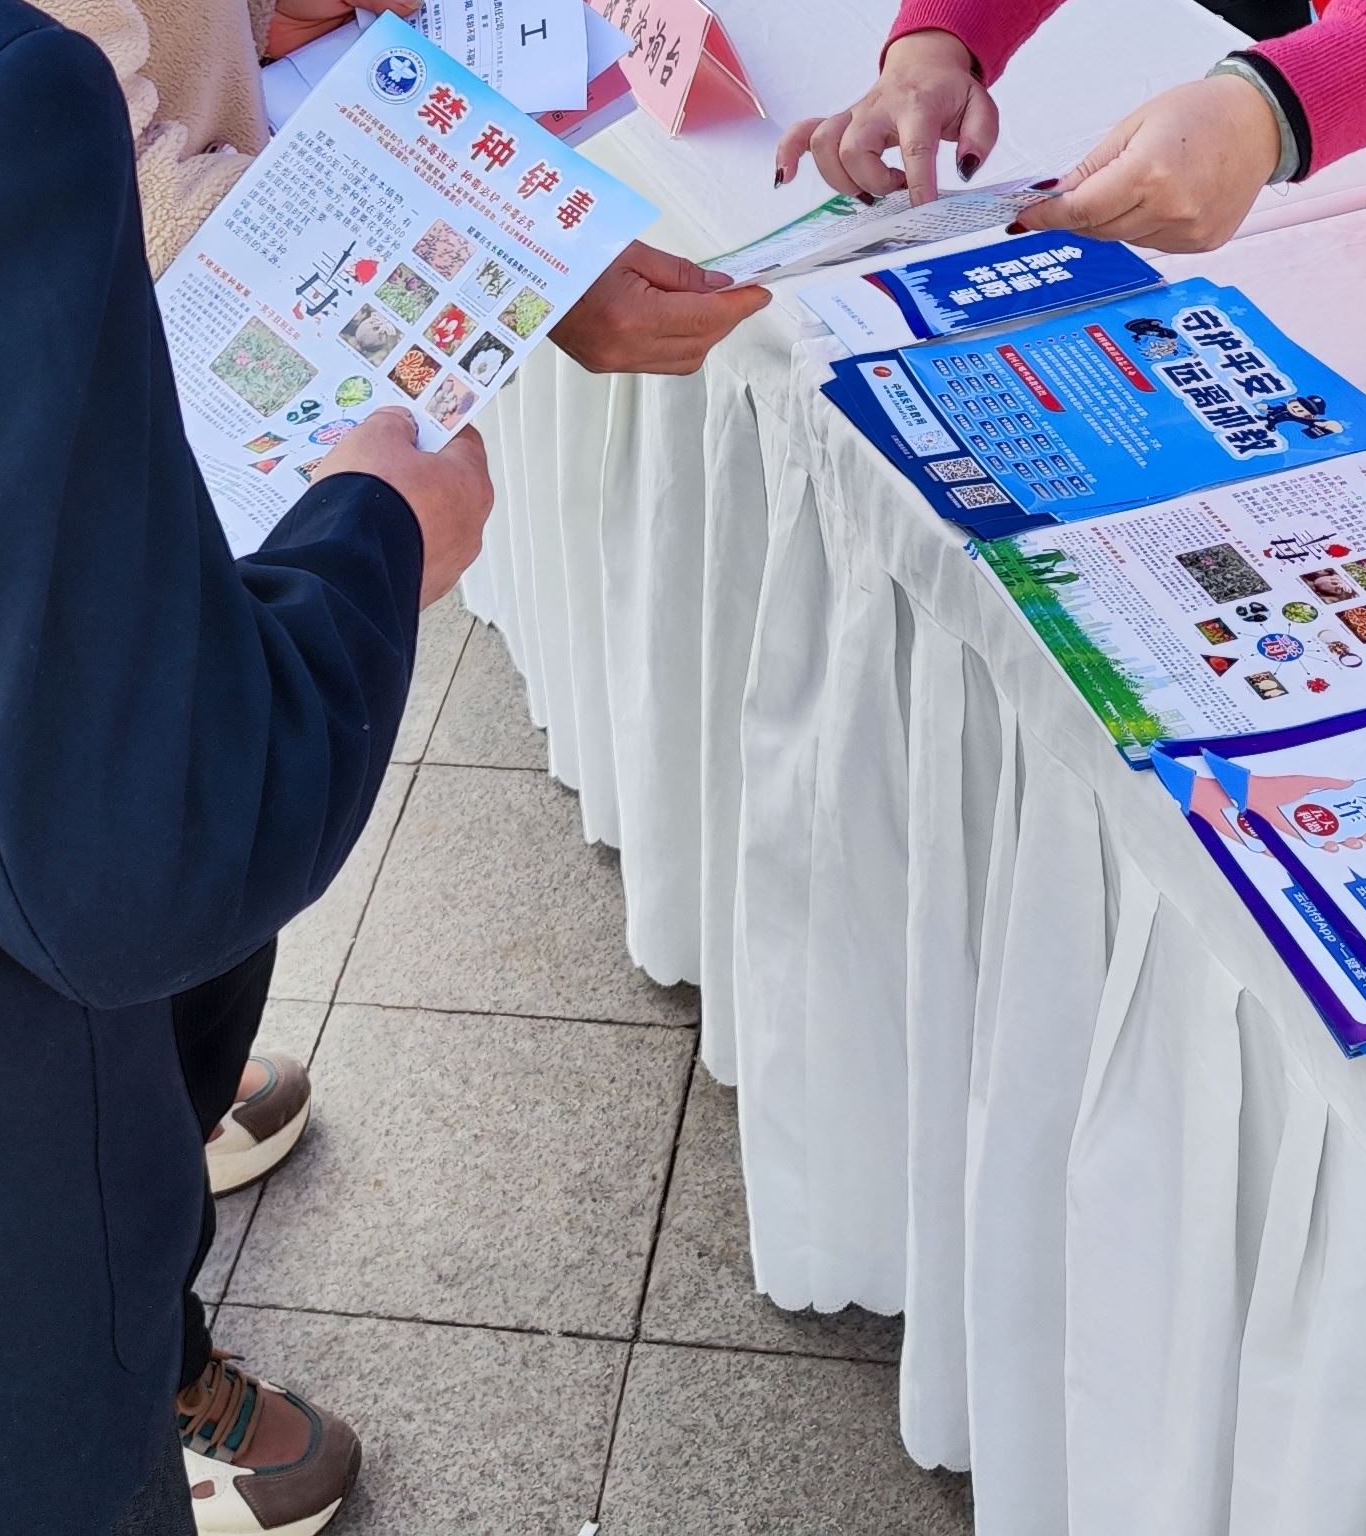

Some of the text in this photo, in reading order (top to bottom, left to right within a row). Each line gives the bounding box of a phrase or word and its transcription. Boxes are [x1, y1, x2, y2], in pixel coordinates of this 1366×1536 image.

[411, 82, 599, 233] 禁种铲毒
[956, 243, 1088, 284] 全民反诈
[1170, 309, 1292, 399] 守护平安
[1158, 360, 1279, 455] 远离邪教
[1289, 809, 1328, 835] 利器
[1306, 807, 1340, 830] 五大
